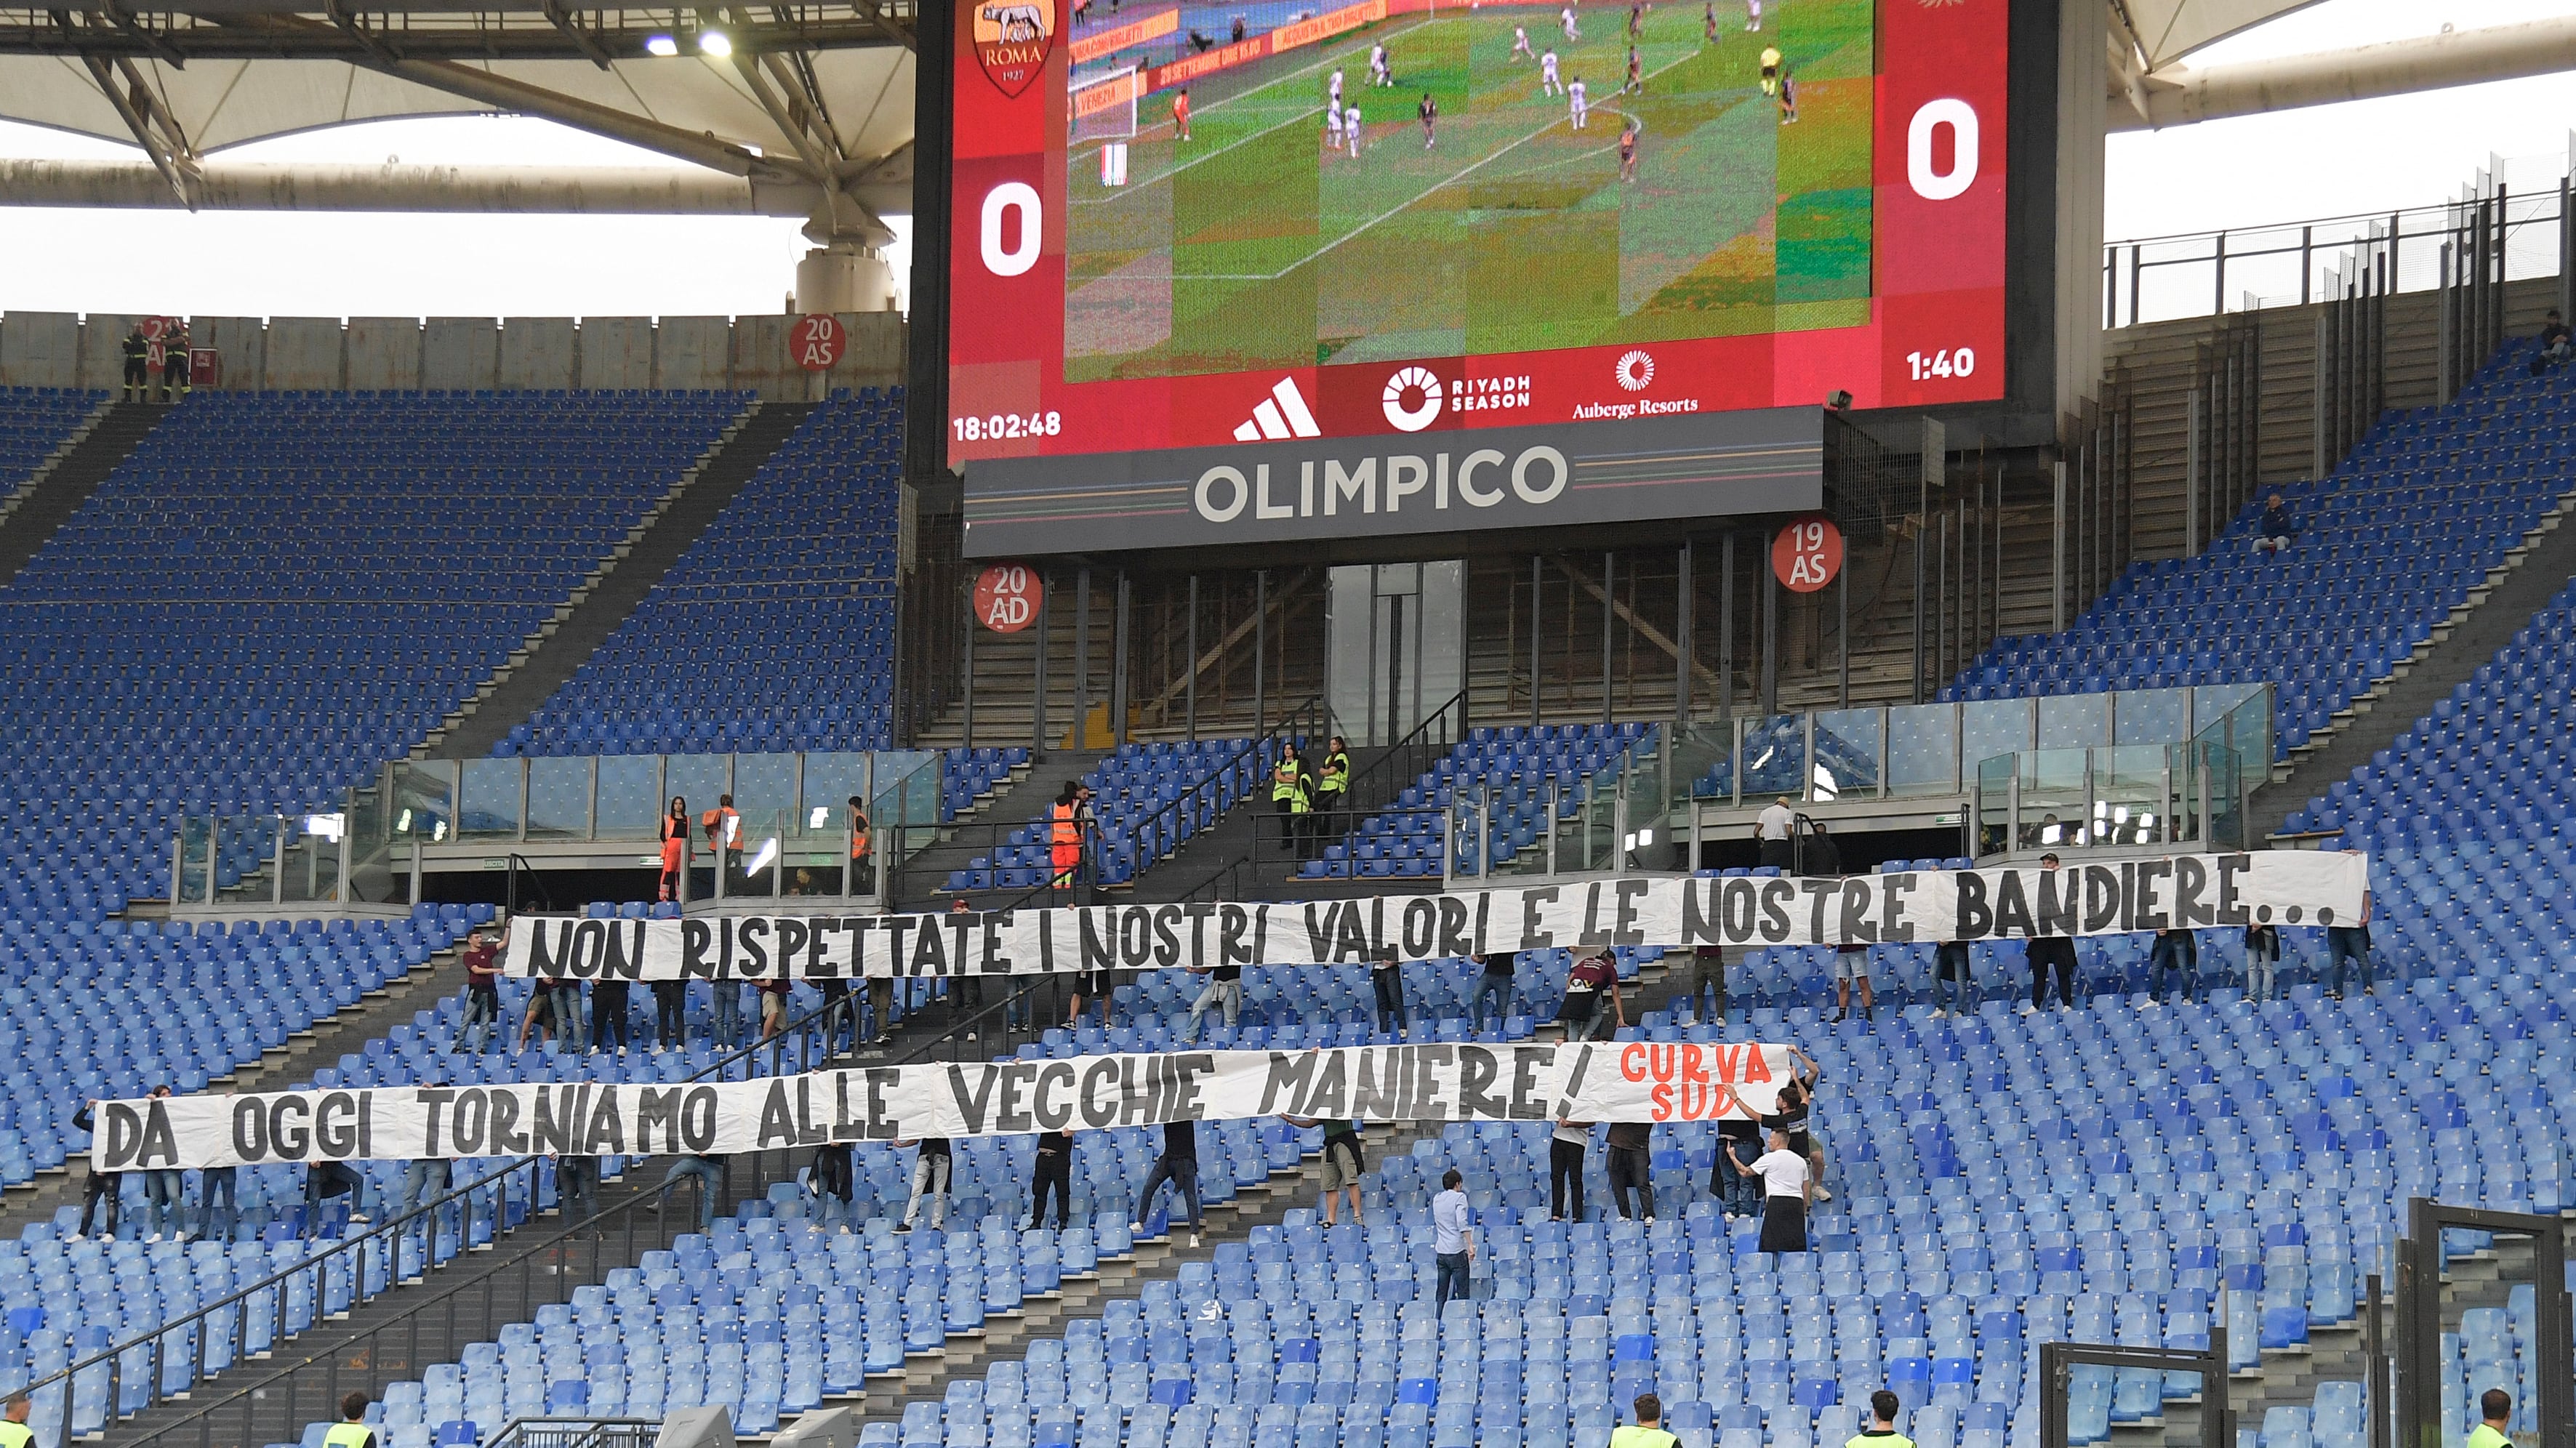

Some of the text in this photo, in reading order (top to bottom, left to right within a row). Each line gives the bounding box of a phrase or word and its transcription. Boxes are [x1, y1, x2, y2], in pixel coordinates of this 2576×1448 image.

[986, 46, 1042, 66] ROMA
[1003, 69, 1024, 81] 1927
[1907, 98, 1979, 200] 0
[980, 182, 1043, 277] 0
[806, 319, 832, 341] 20
[145, 345, 166, 366] A
[803, 343, 832, 365] AS
[1906, 347, 1975, 381] 1:40
[1452, 374, 1530, 395] RIYADH
[1452, 392, 1530, 412] SEASON
[1572, 398, 1698, 419] Auberge Resorts
[953, 411, 1062, 442] 18:02:48
[1194, 445, 1568, 523] OLIMPICO
[1791, 521, 1823, 552] 19
[993, 566, 1026, 594] 20
[1789, 554, 1826, 586] AS
[988, 597, 1030, 624] AD
[527, 919, 646, 979] NON
[680, 911, 1014, 979] RISPETTATE
[1040, 909, 1054, 973] I
[1078, 904, 1269, 970] NOSTRI
[1304, 892, 1490, 964] VALORI
[1520, 887, 1560, 950] E
[1578, 880, 1648, 945] LE
[1681, 873, 1917, 944] NOSTRE
[1621, 1042, 1772, 1083] CURVA
[104, 1044, 1592, 1168] DA OGGI TORNIAMO ALLE VECCHIE MANIERE!
[1651, 1082, 1736, 1121] SUD
